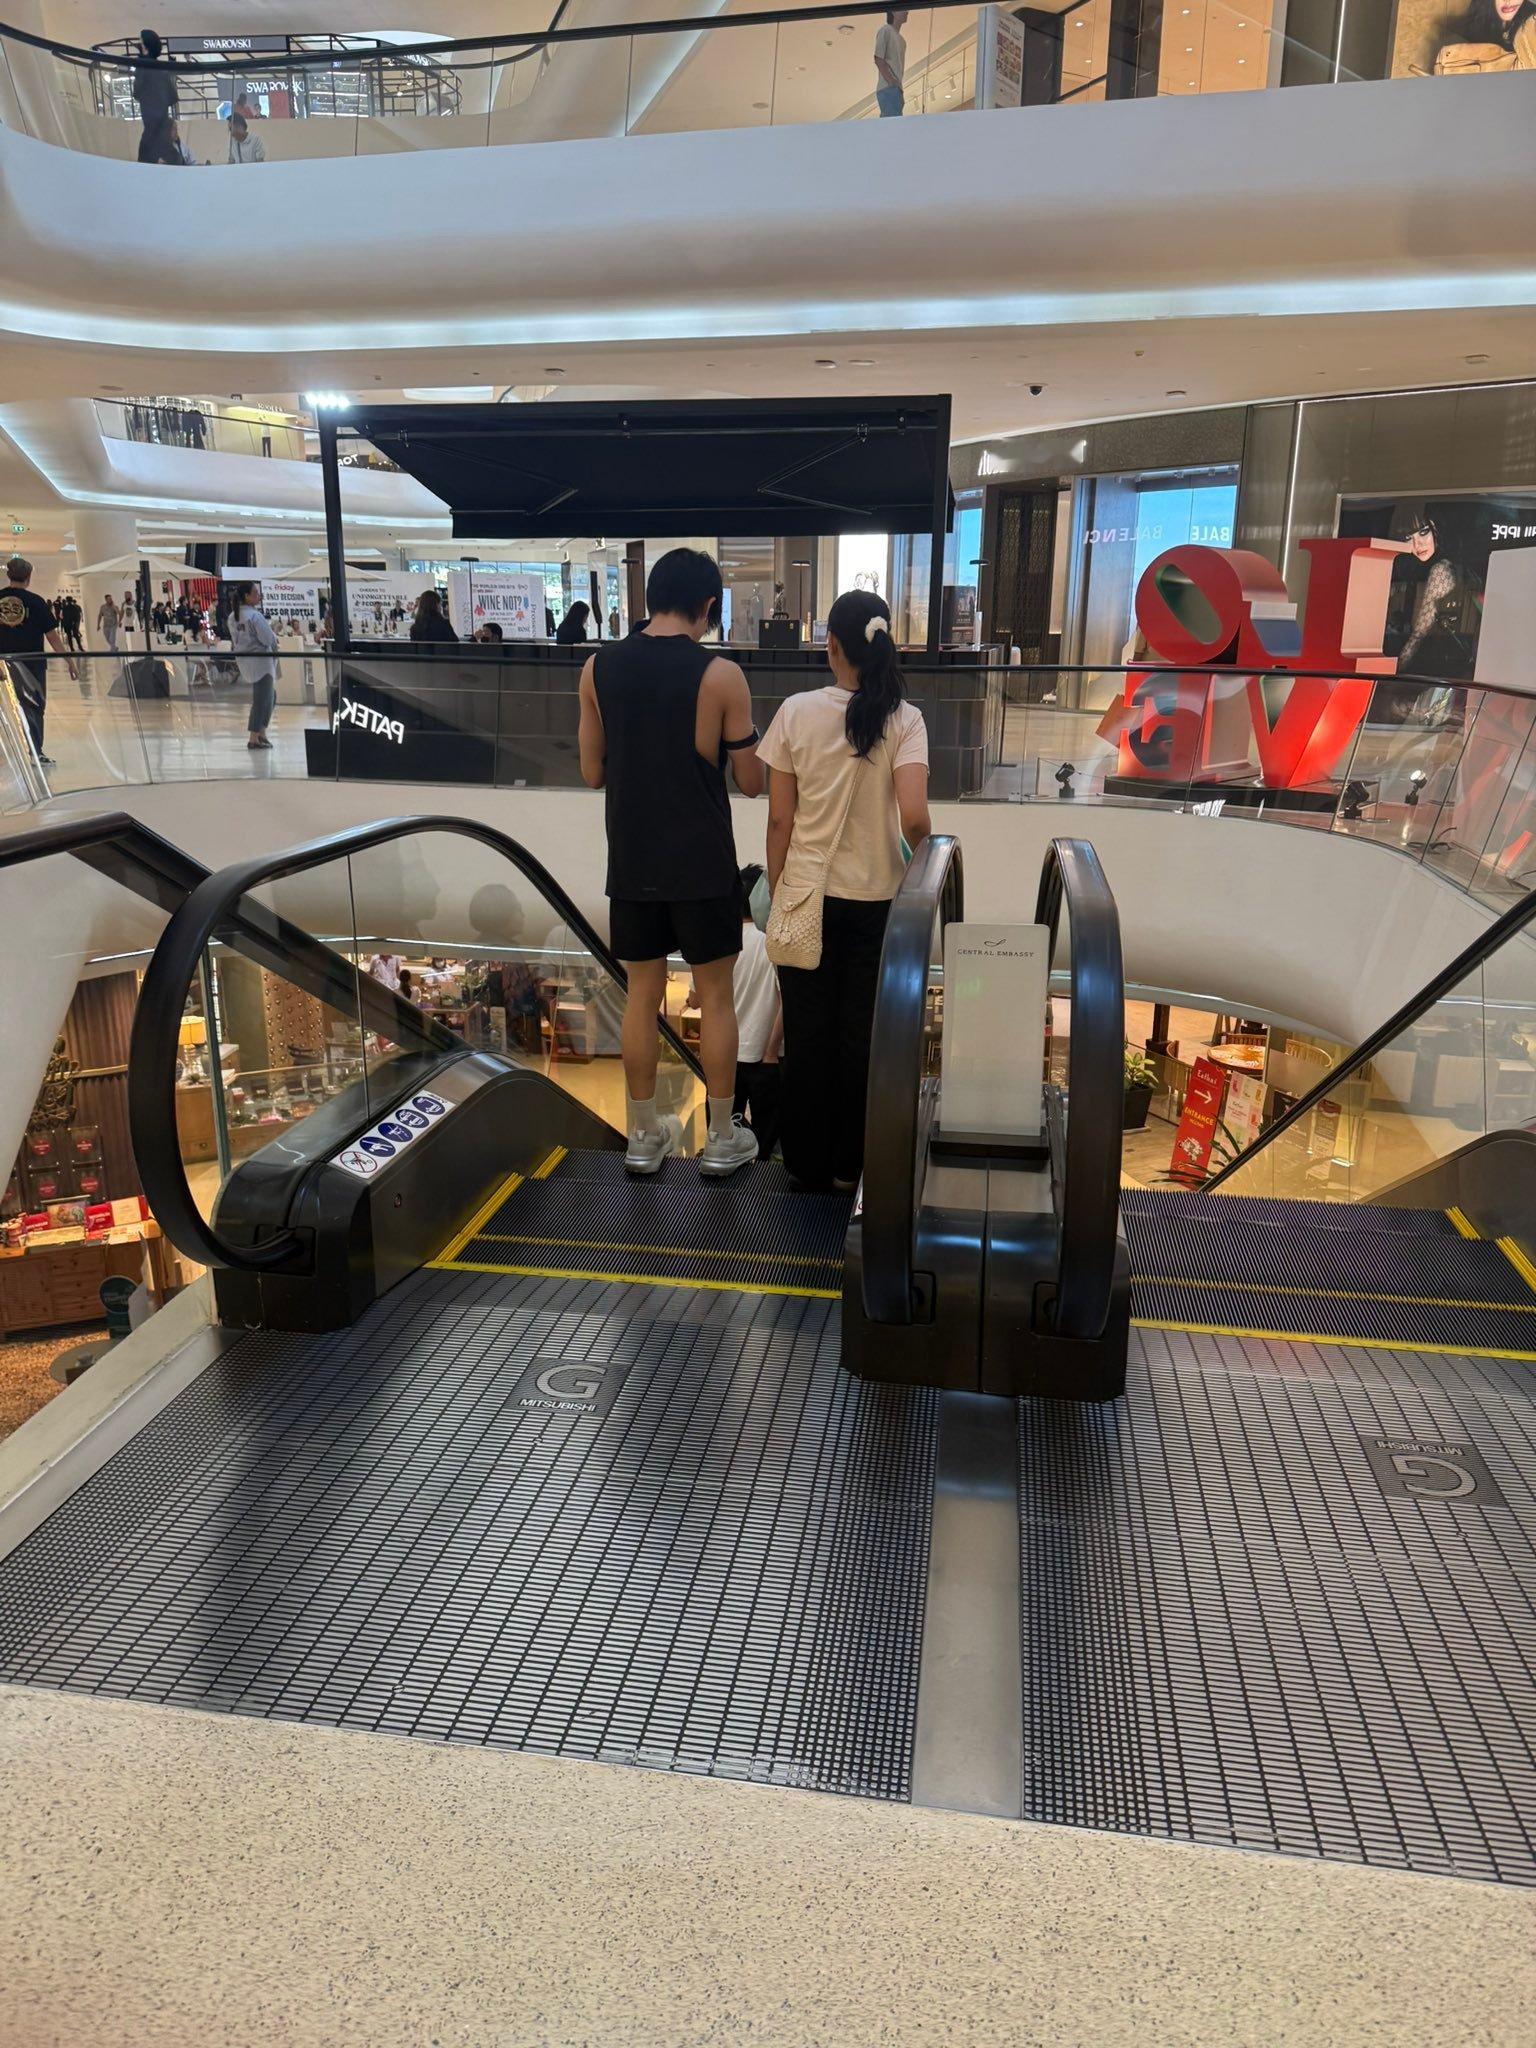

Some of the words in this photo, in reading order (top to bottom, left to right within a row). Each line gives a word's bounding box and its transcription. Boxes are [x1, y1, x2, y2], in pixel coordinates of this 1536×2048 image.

[203, 39, 252, 49] SWAROVSKI
[274, 584, 295, 592] friday
[478, 594, 501, 611] WINE
[503, 595, 522, 611] NOT?
[290, 609, 315, 617] BOTTLE
[1184, 1106, 1215, 1126] ENTRANCE
[535, 1364, 607, 1399] G
[520, 1398, 597, 1412] MITSUBISHI
[1377, 1440, 1464, 1456] MITSUBISHI
